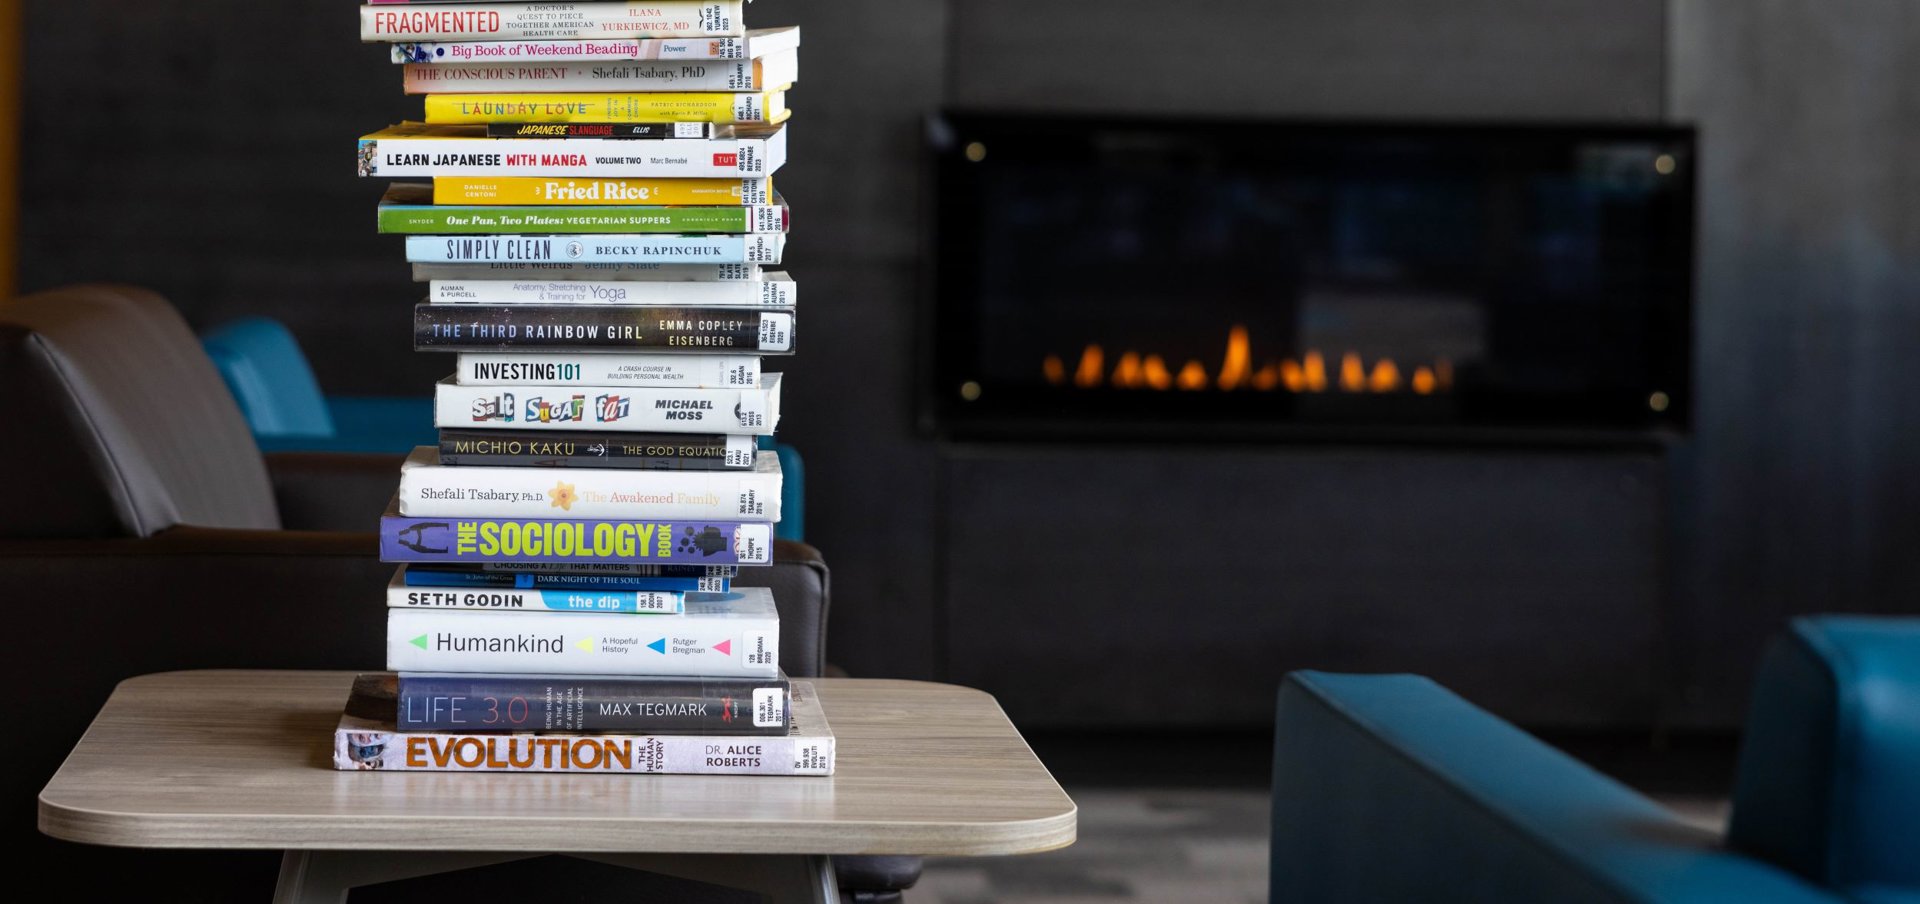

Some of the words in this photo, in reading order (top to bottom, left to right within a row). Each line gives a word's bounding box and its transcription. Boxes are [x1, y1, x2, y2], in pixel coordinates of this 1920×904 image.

[375, 11, 500, 34] FRAGMENTED
[602, 22, 672, 31] YURKIEWICZ,
[452, 46, 472, 58] Big
[475, 45, 506, 56] Book
[508, 44, 522, 55] of
[525, 44, 582, 55] Weekend
[585, 44, 638, 57] Beading
[663, 44, 687, 53] Power
[415, 69, 441, 80] THE
[444, 68, 515, 80] CONSCIOUS
[518, 68, 567, 79] PARENT
[592, 67, 630, 79] Shefali
[632, 67, 678, 81] Tsabary,
[682, 67, 705, 78] PhD
[462, 102, 537, 115] LAUNDRY
[546, 102, 587, 114] LOVE
[517, 125, 569, 135] JAPANESE
[569, 125, 614, 135] SLANGUAGE
[387, 154, 429, 166] LEARN
[433, 154, 501, 166] JAPANESE
[506, 154, 536, 166] WITH
[541, 154, 587, 166] MANGA
[545, 182, 601, 199] Fried
[604, 182, 649, 199] Rice
[446, 216, 470, 225] One
[472, 216, 497, 226] Pan,
[501, 216, 522, 225] Two
[524, 216, 564, 225] Plates:
[447, 240, 499, 260] SIMPLY
[508, 240, 551, 260] CLEAN
[596, 246, 638, 255] BECKY
[643, 246, 721, 255] RAPINCHUK
[513, 284, 547, 292] Anatomy,
[549, 284, 586, 292] Stretching
[590, 284, 626, 302] Yoga
[547, 293, 574, 301] Training
[433, 324, 461, 338] THE
[470, 324, 517, 338] THIRD
[526, 326, 598, 338] RAINBOW
[607, 326, 642, 339] GIRL
[660, 320, 692, 330] EMMA
[699, 321, 742, 330] COPLEY
[669, 336, 733, 346] EISENBERG
[474, 363, 581, 380] INVESTING101
[655, 400, 713, 409] MICHAEL
[666, 411, 703, 420] MOSS
[455, 441, 522, 454] MICHIO
[530, 442, 575, 455] KAKU
[623, 446, 642, 455] THE
[646, 446, 674, 456] GOD
[421, 487, 464, 499] Shefali
[468, 488, 519, 502] Tsabary,
[522, 493, 543, 501] Ph.D.
[583, 491, 606, 502] The
[610, 492, 673, 504] Awakened
[677, 492, 720, 506] Family
[458, 522, 477, 555] THE
[479, 522, 655, 557] SOCIOLOGY
[658, 524, 672, 557] BOOK
[408, 593, 457, 606] SETH
[464, 594, 523, 607] GODIN
[568, 596, 592, 608] the
[597, 596, 620, 610] dip
[437, 633, 563, 653] Humankind
[610, 638, 638, 646] Hopeful
[673, 638, 697, 647] Rutger
[673, 646, 705, 655] Bregman
[408, 697, 466, 723] LIFE
[482, 696, 528, 724] 3.0
[600, 703, 631, 716] MAX
[637, 703, 707, 716] TEGMARK
[406, 737, 632, 769] EVOLUTION
[656, 741, 664, 770] STORY
[706, 745, 724, 755] DR.
[727, 746, 762, 755] ALICE
[706, 757, 761, 767] ROBERTS
